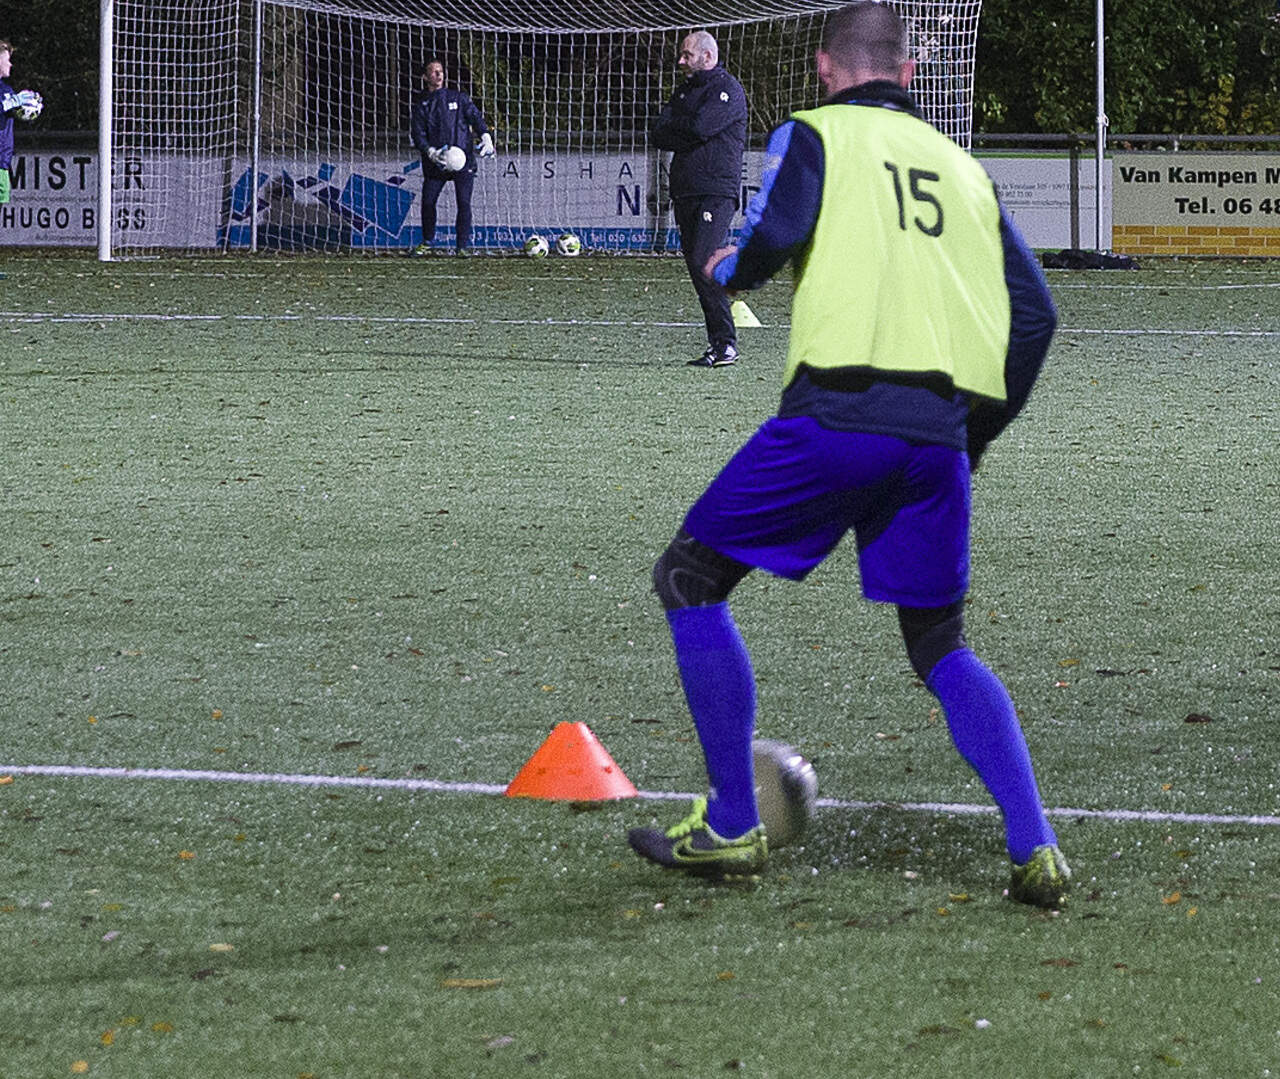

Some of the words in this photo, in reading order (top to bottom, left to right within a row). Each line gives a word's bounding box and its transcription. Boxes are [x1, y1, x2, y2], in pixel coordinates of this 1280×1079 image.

[9, 156, 146, 191] MISTR
[1119, 166, 1160, 185] Van
[1167, 167, 1257, 189] Kampen
[884, 161, 944, 238] 15
[1174, 198, 1217, 216] Tel.
[1223, 198, 1253, 216] 06
[2, 207, 70, 230] HUGO
[82, 207, 146, 231] BSS
